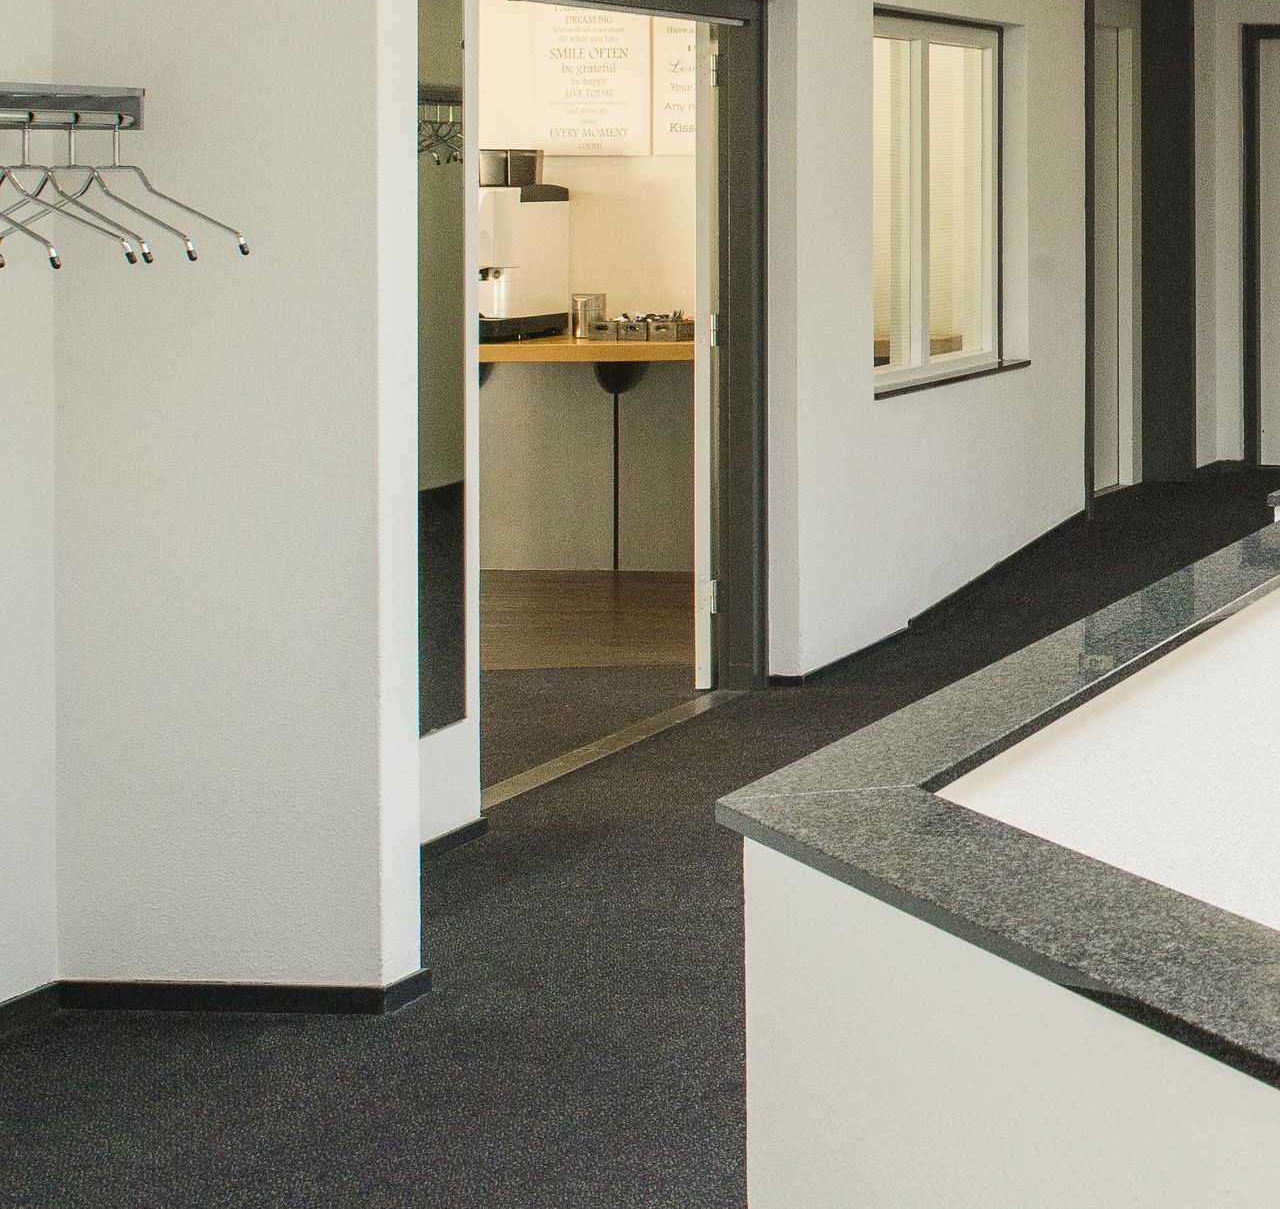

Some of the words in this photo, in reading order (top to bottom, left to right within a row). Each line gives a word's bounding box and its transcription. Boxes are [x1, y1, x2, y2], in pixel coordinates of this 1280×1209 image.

[565, 15, 596, 24] DREAM
[666, 26, 687, 34] Have
[549, 47, 586, 59] SMILE
[589, 47, 629, 59] OFTEN
[561, 62, 573, 73] be
[575, 62, 616, 76] grateful
[670, 83, 692, 91] Your
[664, 102, 686, 113] Any
[550, 127, 579, 138] EVERY
[581, 127, 629, 138] MOMENT
[669, 123, 694, 133] Kiss
